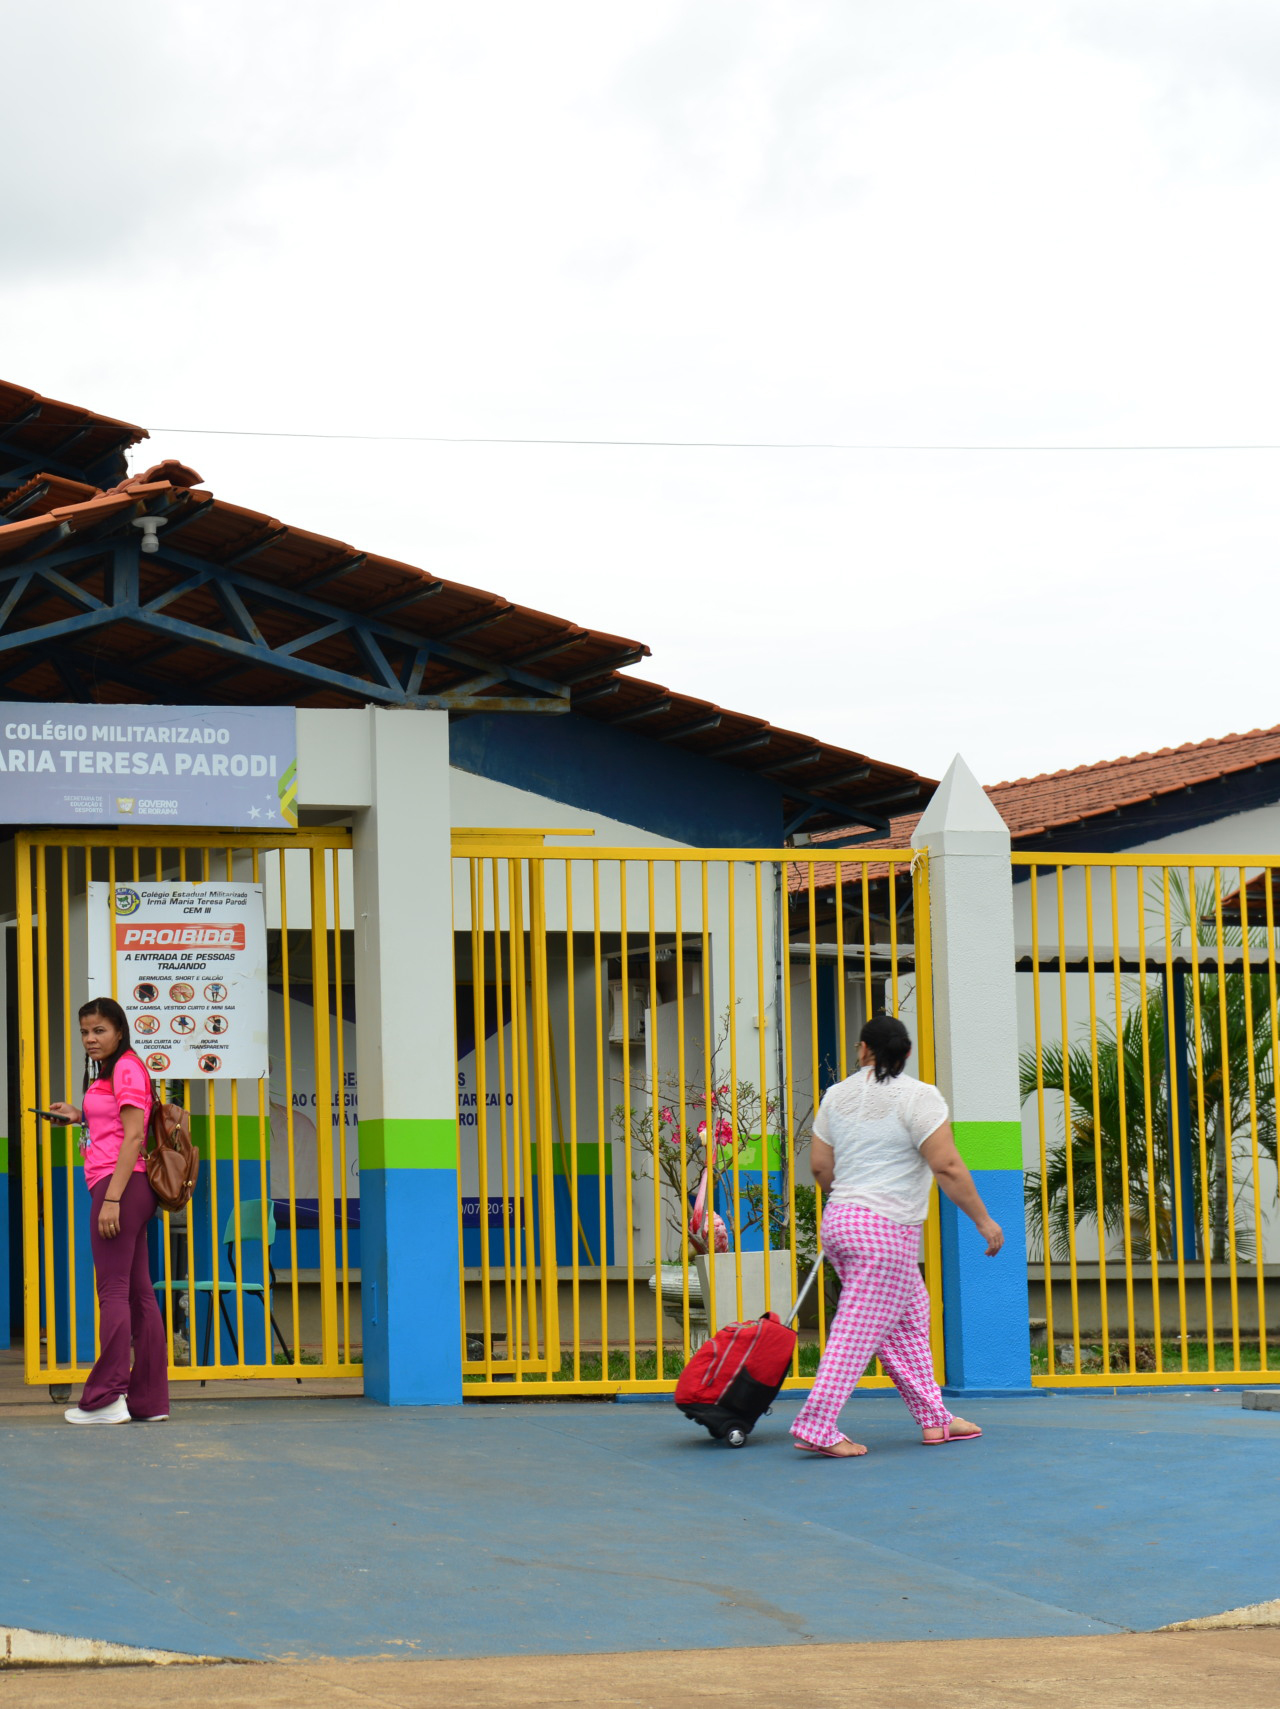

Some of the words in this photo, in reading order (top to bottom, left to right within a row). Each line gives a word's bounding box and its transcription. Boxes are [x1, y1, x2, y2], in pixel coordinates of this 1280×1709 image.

[5, 720, 87, 740] COLÉGIO
[92, 726, 230, 744] MILITARIZADO
[60, 751, 170, 775] TERESA
[175, 754, 277, 777] PARODI
[138, 800, 178, 808] GOVERNO
[124, 929, 235, 945] PROIBIDO
[292, 1094, 307, 1106] AO
